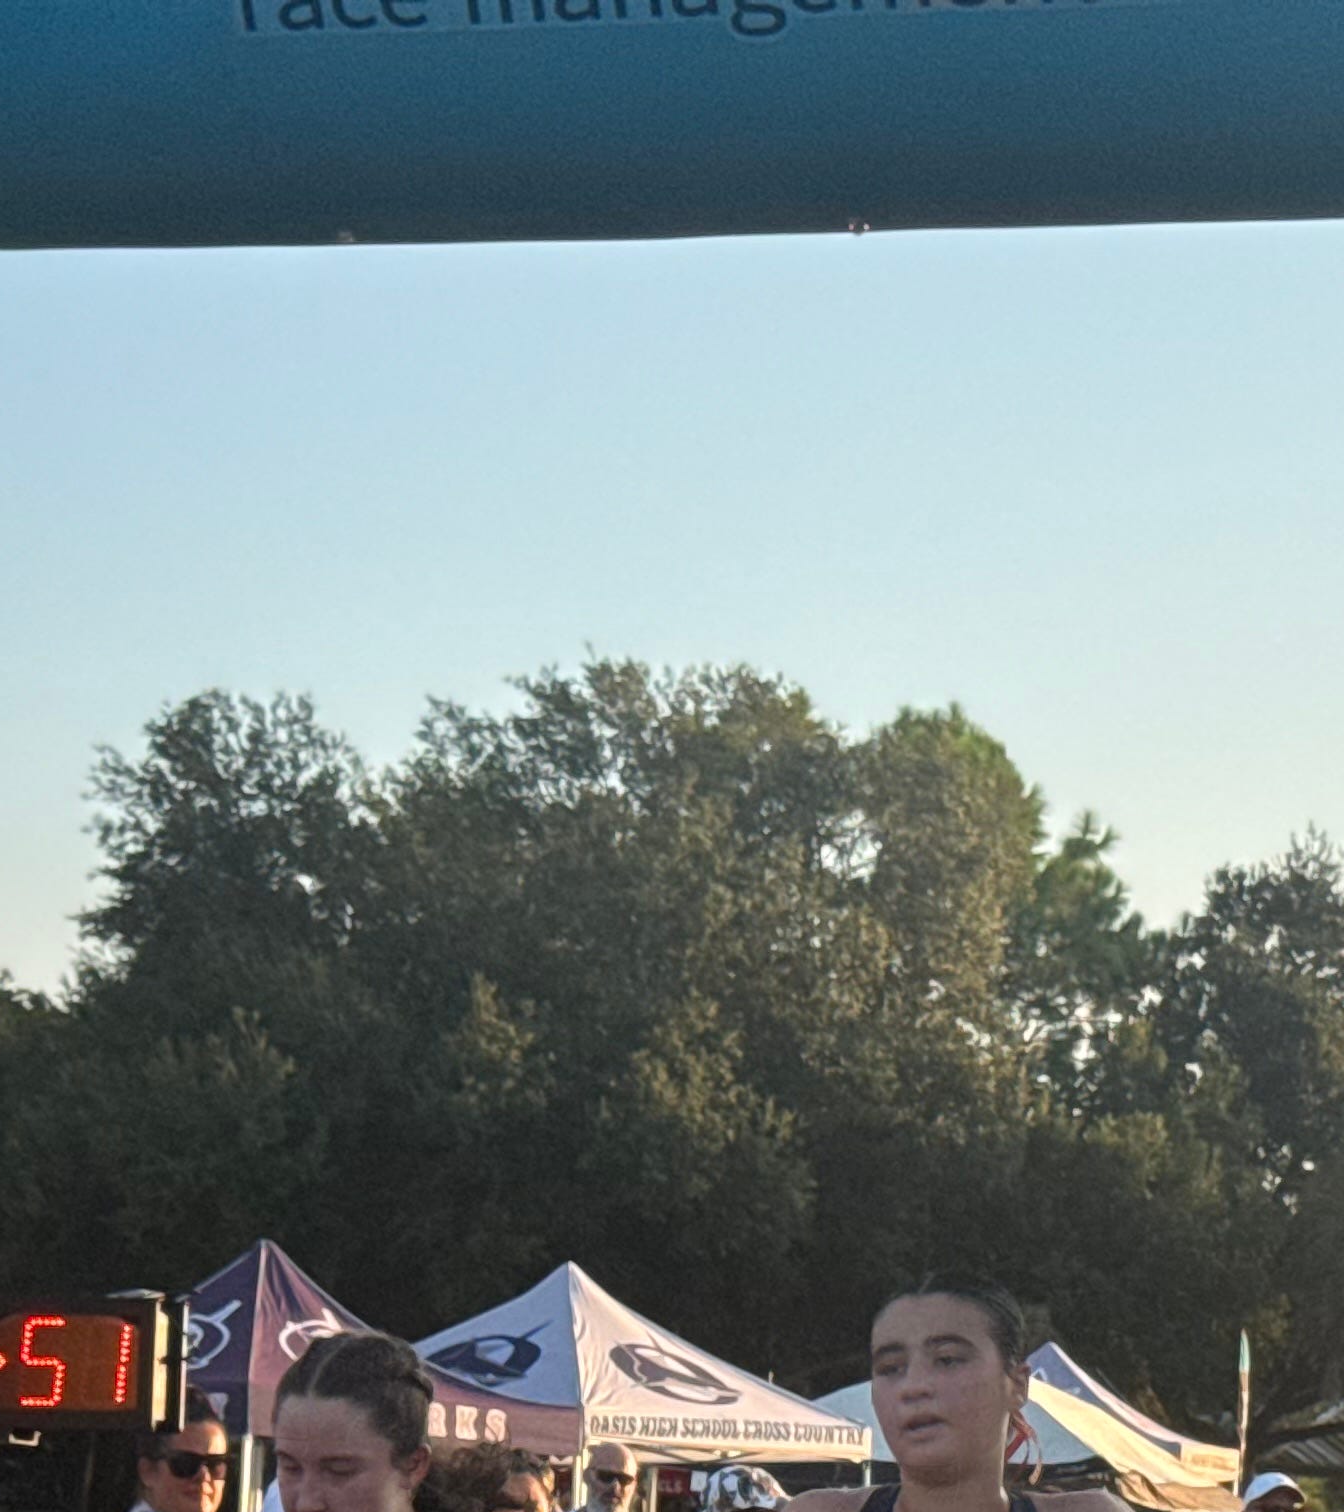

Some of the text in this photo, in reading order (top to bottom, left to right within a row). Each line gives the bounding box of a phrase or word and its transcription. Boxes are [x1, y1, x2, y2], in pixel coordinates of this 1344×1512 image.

[590, 1415, 864, 1446] OASIS HIGH SCHOOL CROSS COUNTRY
